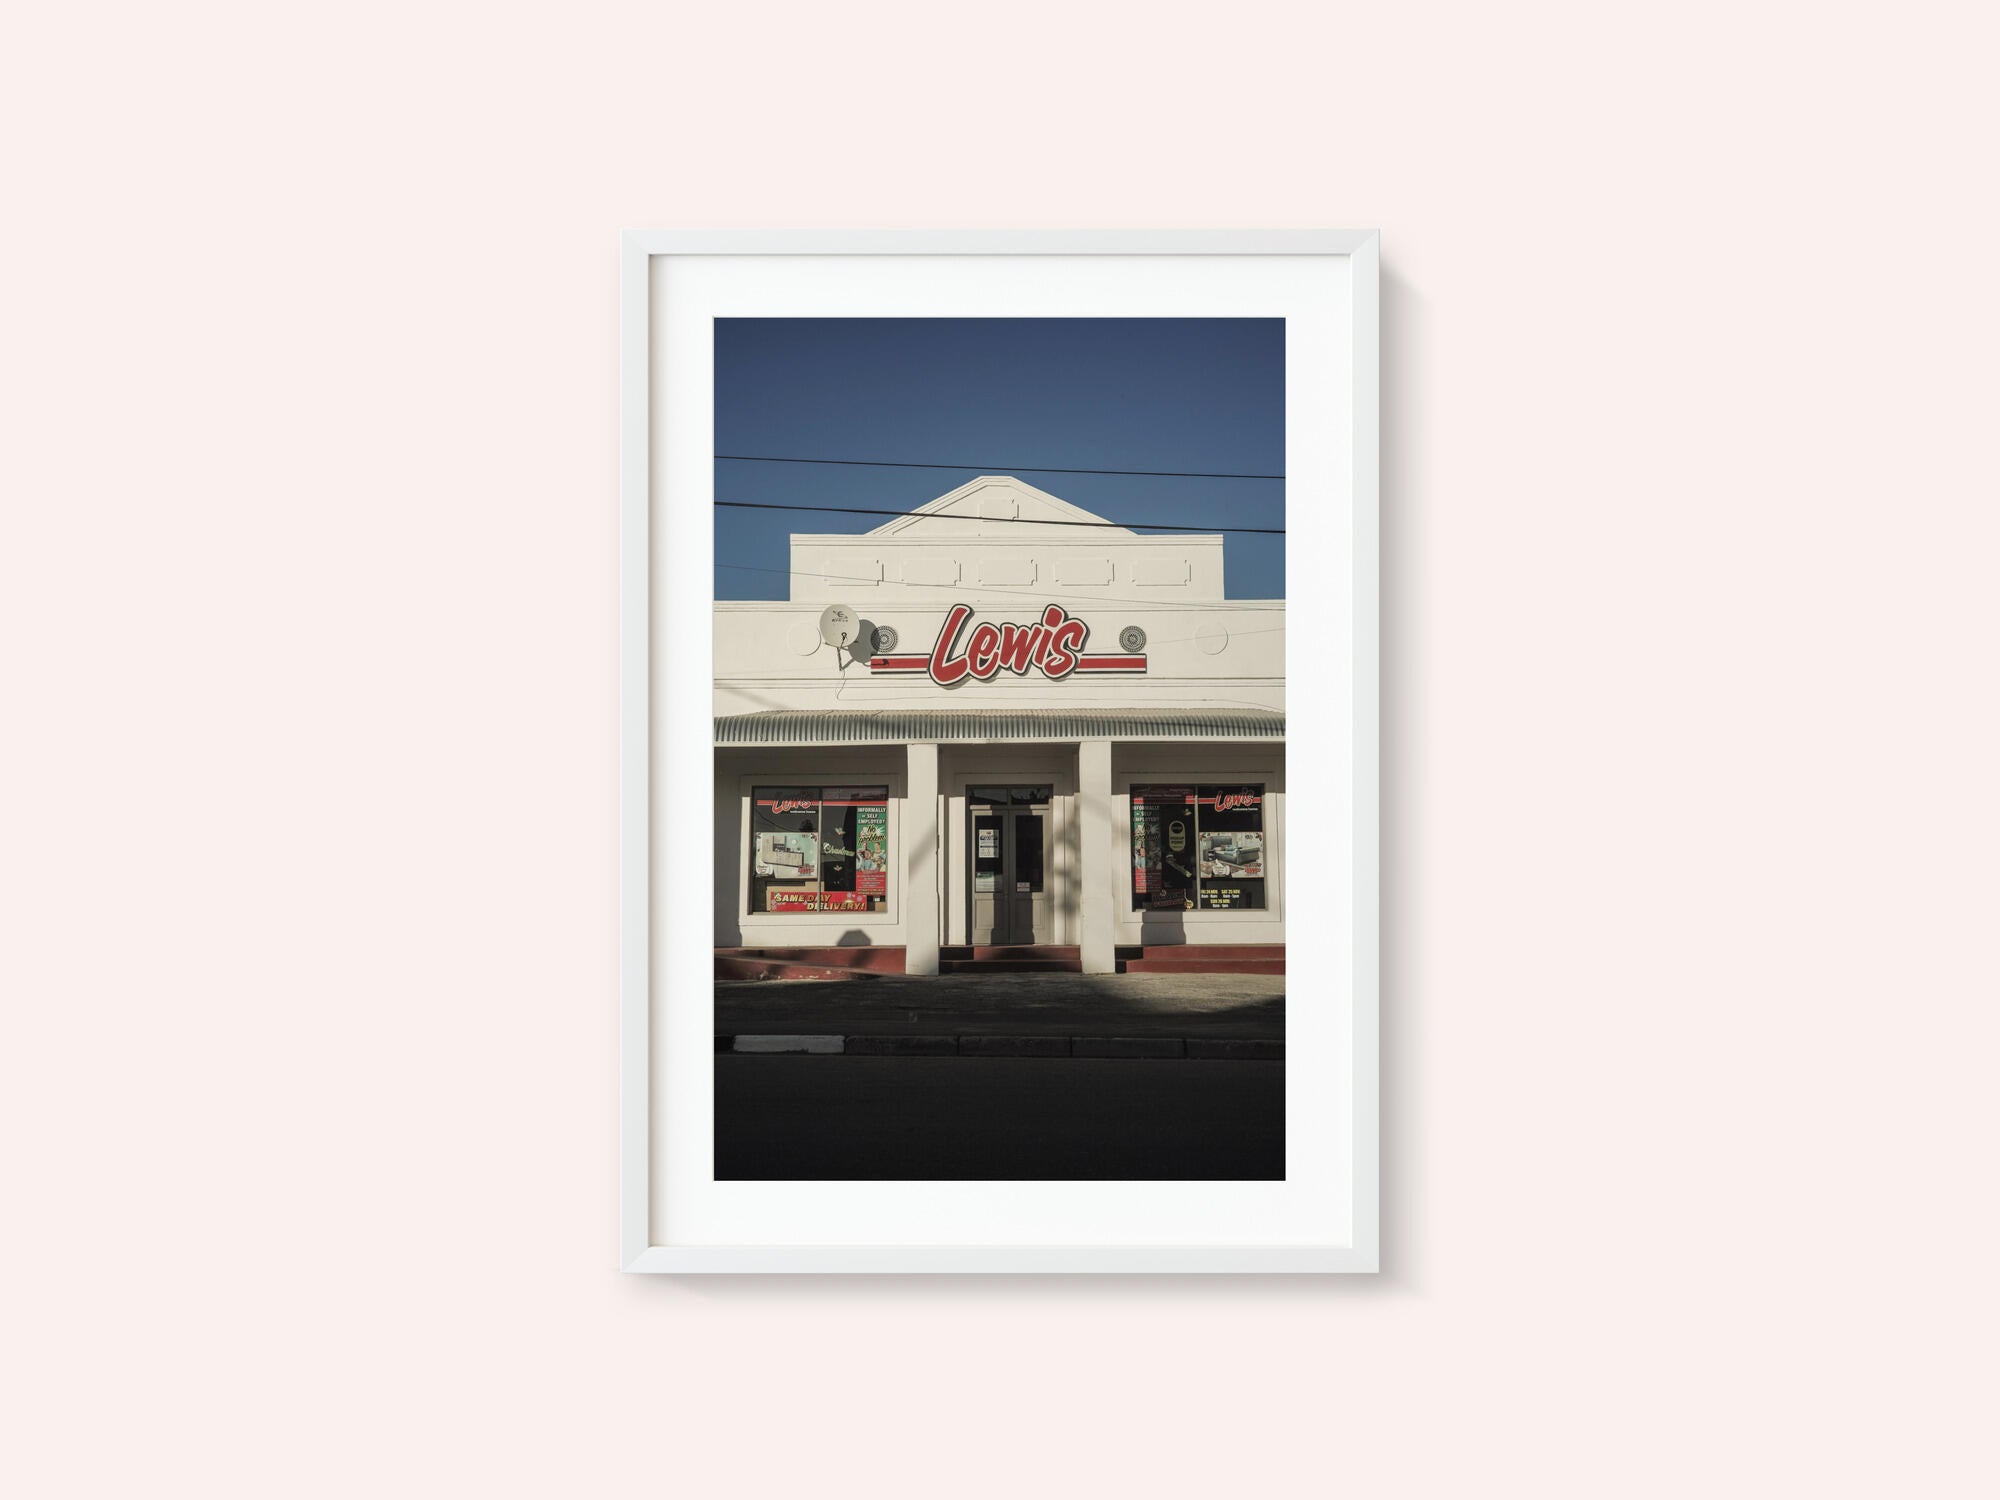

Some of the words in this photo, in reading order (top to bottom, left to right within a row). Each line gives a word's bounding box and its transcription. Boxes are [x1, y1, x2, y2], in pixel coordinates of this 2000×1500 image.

[928, 603, 1090, 689] Lewis
[1215, 789, 1254, 812] Lewis
[867, 824, 877, 833] No
[774, 892, 805, 902] SAME
[807, 893, 832, 902] DAY
